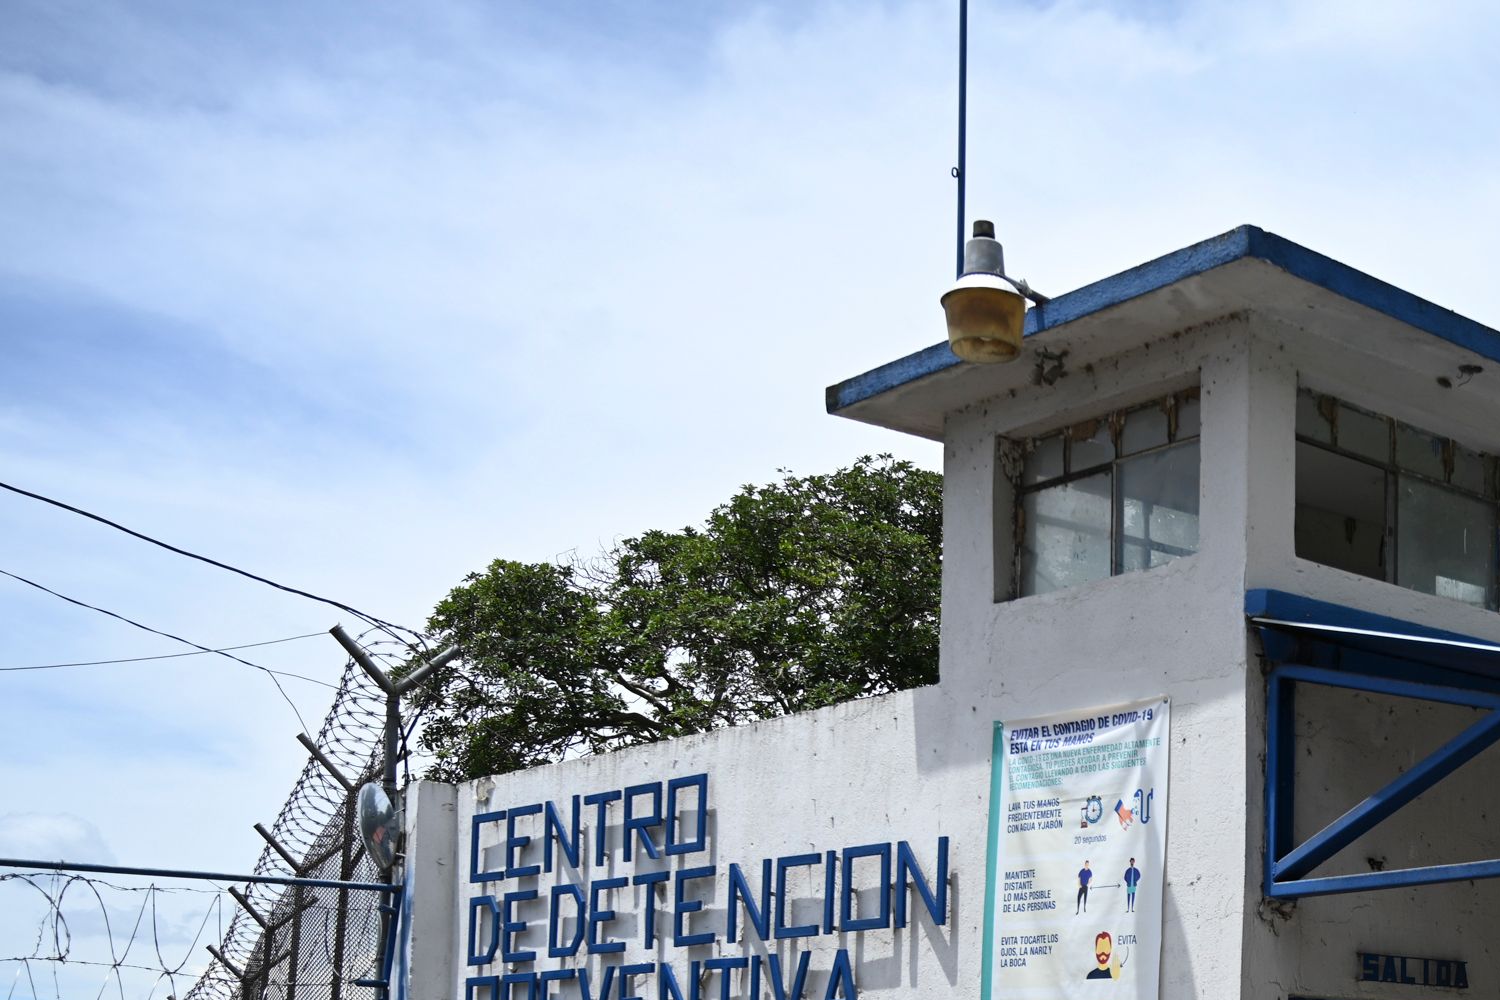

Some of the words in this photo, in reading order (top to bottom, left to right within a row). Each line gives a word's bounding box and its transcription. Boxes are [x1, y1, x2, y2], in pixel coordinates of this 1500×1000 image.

[1010, 727, 1039, 741] EVITAR
[1041, 725, 1052, 738] EL
[1053, 718, 1096, 736] CONTAGIO
[1098, 716, 1110, 729] DE
[1112, 708, 1153, 727] COVID-19
[1031, 740, 1042, 752] EN
[1044, 737, 1061, 750] TUS
[1062, 732, 1095, 747] MANOS
[1042, 752, 1050, 761] ES
[1050, 750, 1062, 760] UNA
[1063, 748, 1081, 758] NUEVA
[1083, 742, 1123, 755] ENFERMEDAD
[1123, 737, 1161, 750] ALTAMENTE
[1054, 758, 1076, 768] PUEDES
[1077, 754, 1101, 765] AYUDAR
[1102, 753, 1107, 762] A
[1107, 749, 1138, 761] PREVENIR
[1016, 771, 1044, 782] CONTAGIO
[1045, 767, 1073, 778] LLEVANDO
[1081, 764, 1097, 774] CABO
[1098, 762, 1110, 771] LAS
[1111, 757, 1147, 769] SIGUIENTES
[1008, 801, 1021, 812] LAVA
[1023, 800, 1035, 810] TUS
[1037, 797, 1060, 808] MANOS
[1008, 808, 1062, 823] FRECUENTEMENTE
[469, 772, 709, 883] CENTRO
[1007, 824, 1019, 834] CON
[1019, 822, 1036, 833] AGUA
[1038, 821, 1042, 830] Y
[1042, 818, 1063, 830] JABÓN
[1074, 836, 1082, 845] 20
[1082, 834, 1107, 845] segundos
[1005, 869, 1035, 880] MANTENTE
[1004, 880, 1033, 891] DISTANTE
[467, 889, 539, 967] DE
[548, 836, 950, 959] DETENCION
[1003, 893, 1012, 902] LO
[1028, 889, 1051, 901] POSIBLE
[1003, 903, 1012, 913] DE
[1012, 903, 1026, 913] LAS
[1026, 900, 1056, 912] PERSONAS
[1001, 936, 1018, 946] EVITA
[1020, 934, 1046, 945] TOCARTE
[1047, 933, 1059, 944] LOS
[1117, 934, 1138, 945] EVITA
[1019, 946, 1028, 956] LA
[1029, 945, 1047, 955] NARIZ
[1048, 945, 1053, 954] Y
[1000, 958, 1008, 968] LA
[1009, 958, 1026, 967] BOCA
[1361, 953, 1469, 988] SALIDA
